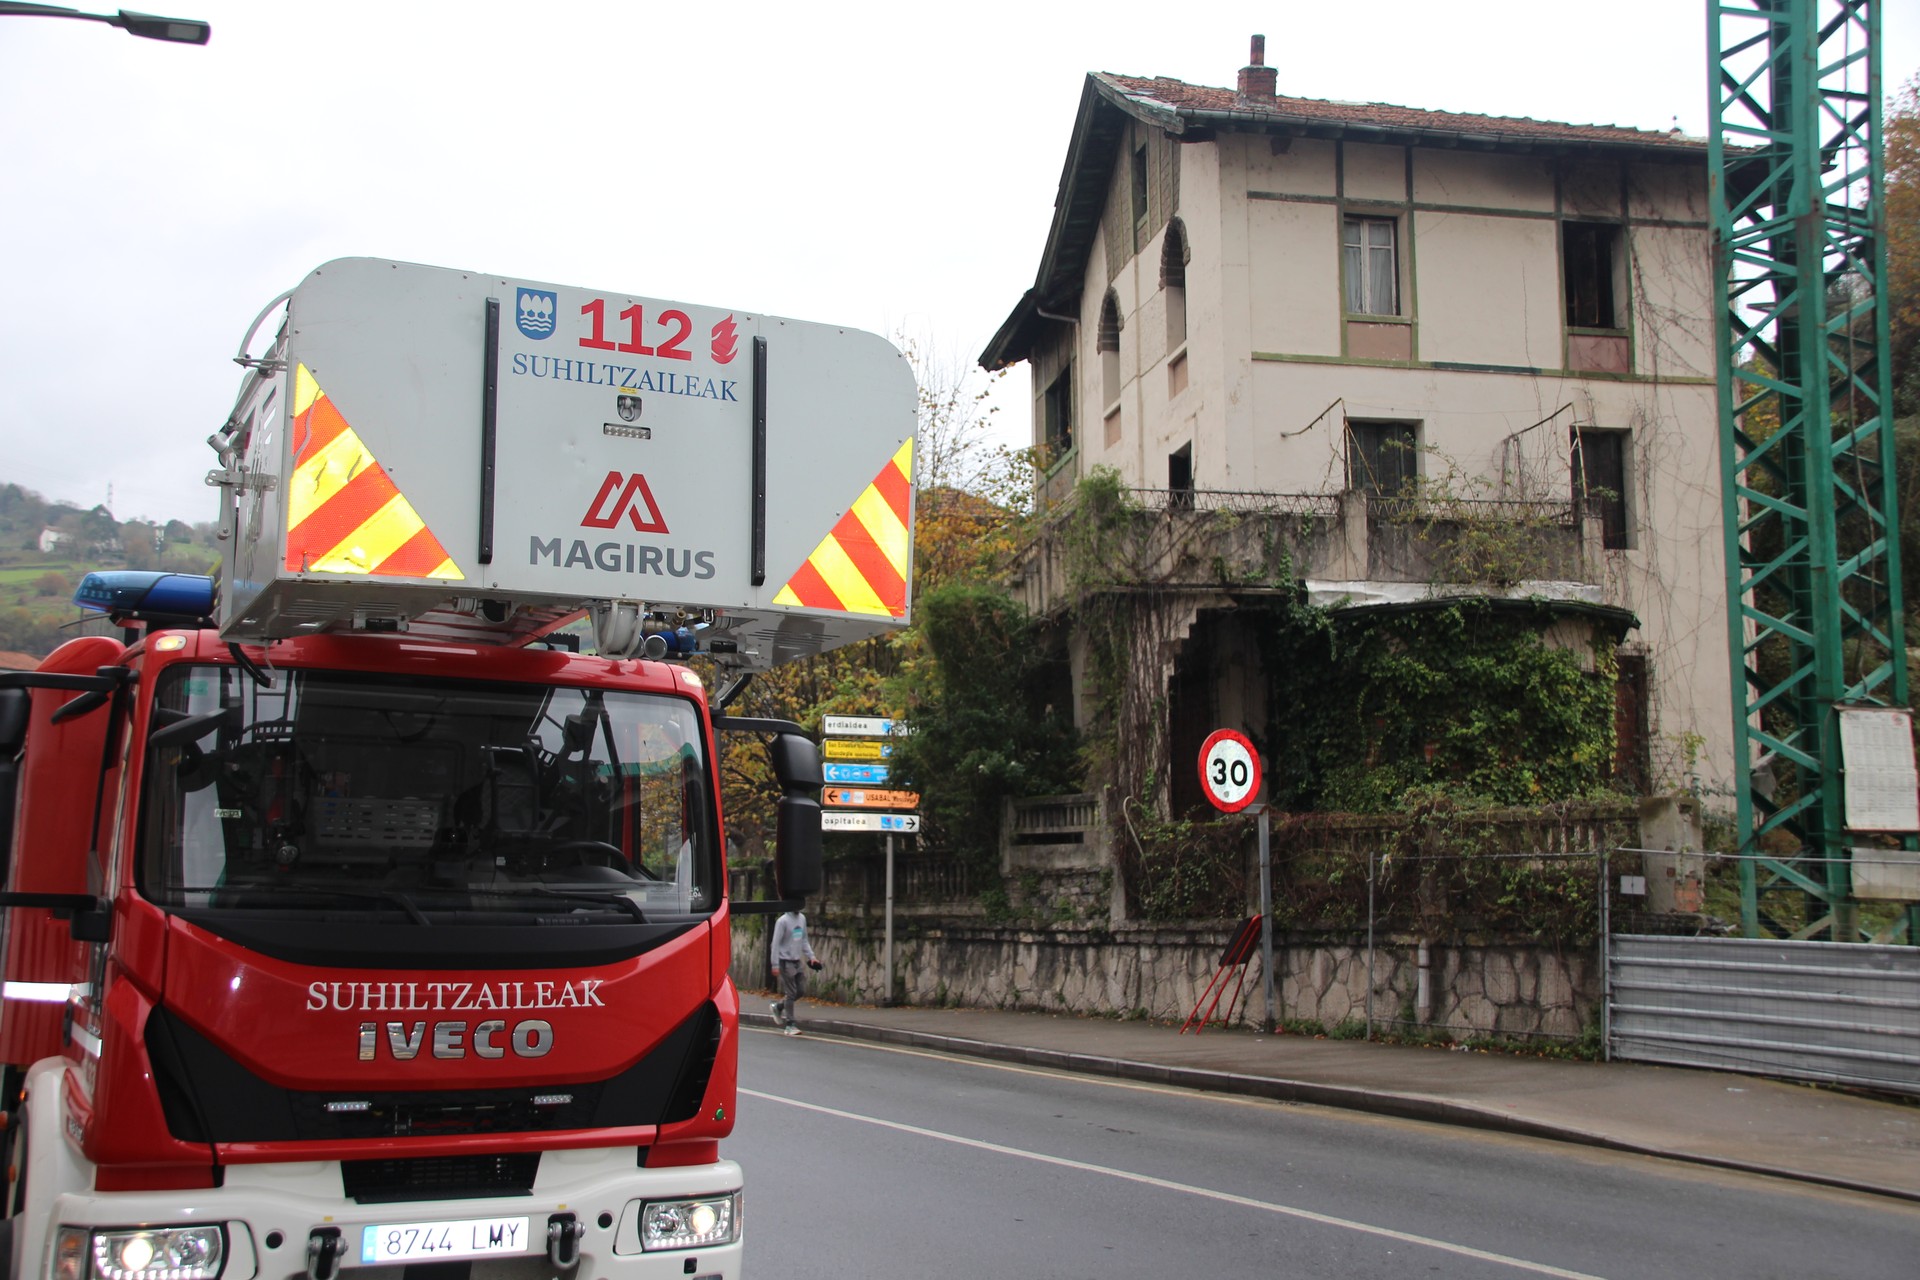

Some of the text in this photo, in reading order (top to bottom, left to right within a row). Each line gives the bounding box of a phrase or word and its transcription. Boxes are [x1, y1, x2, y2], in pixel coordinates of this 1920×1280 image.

[580, 298, 692, 361] 112
[512, 354, 738, 401] SUHILTZAILEAK
[529, 536, 716, 580] MAGIRUS
[827, 721, 868, 729] erdialdea
[1212, 758, 1247, 786] 30
[866, 793, 891, 802] USABAL
[824, 817, 866, 825] ospitalea
[306, 980, 605, 1011] SUHILTZAILEAK
[358, 1019, 554, 1061] IVECO
[386, 1223, 519, 1255] 8744 LMY
